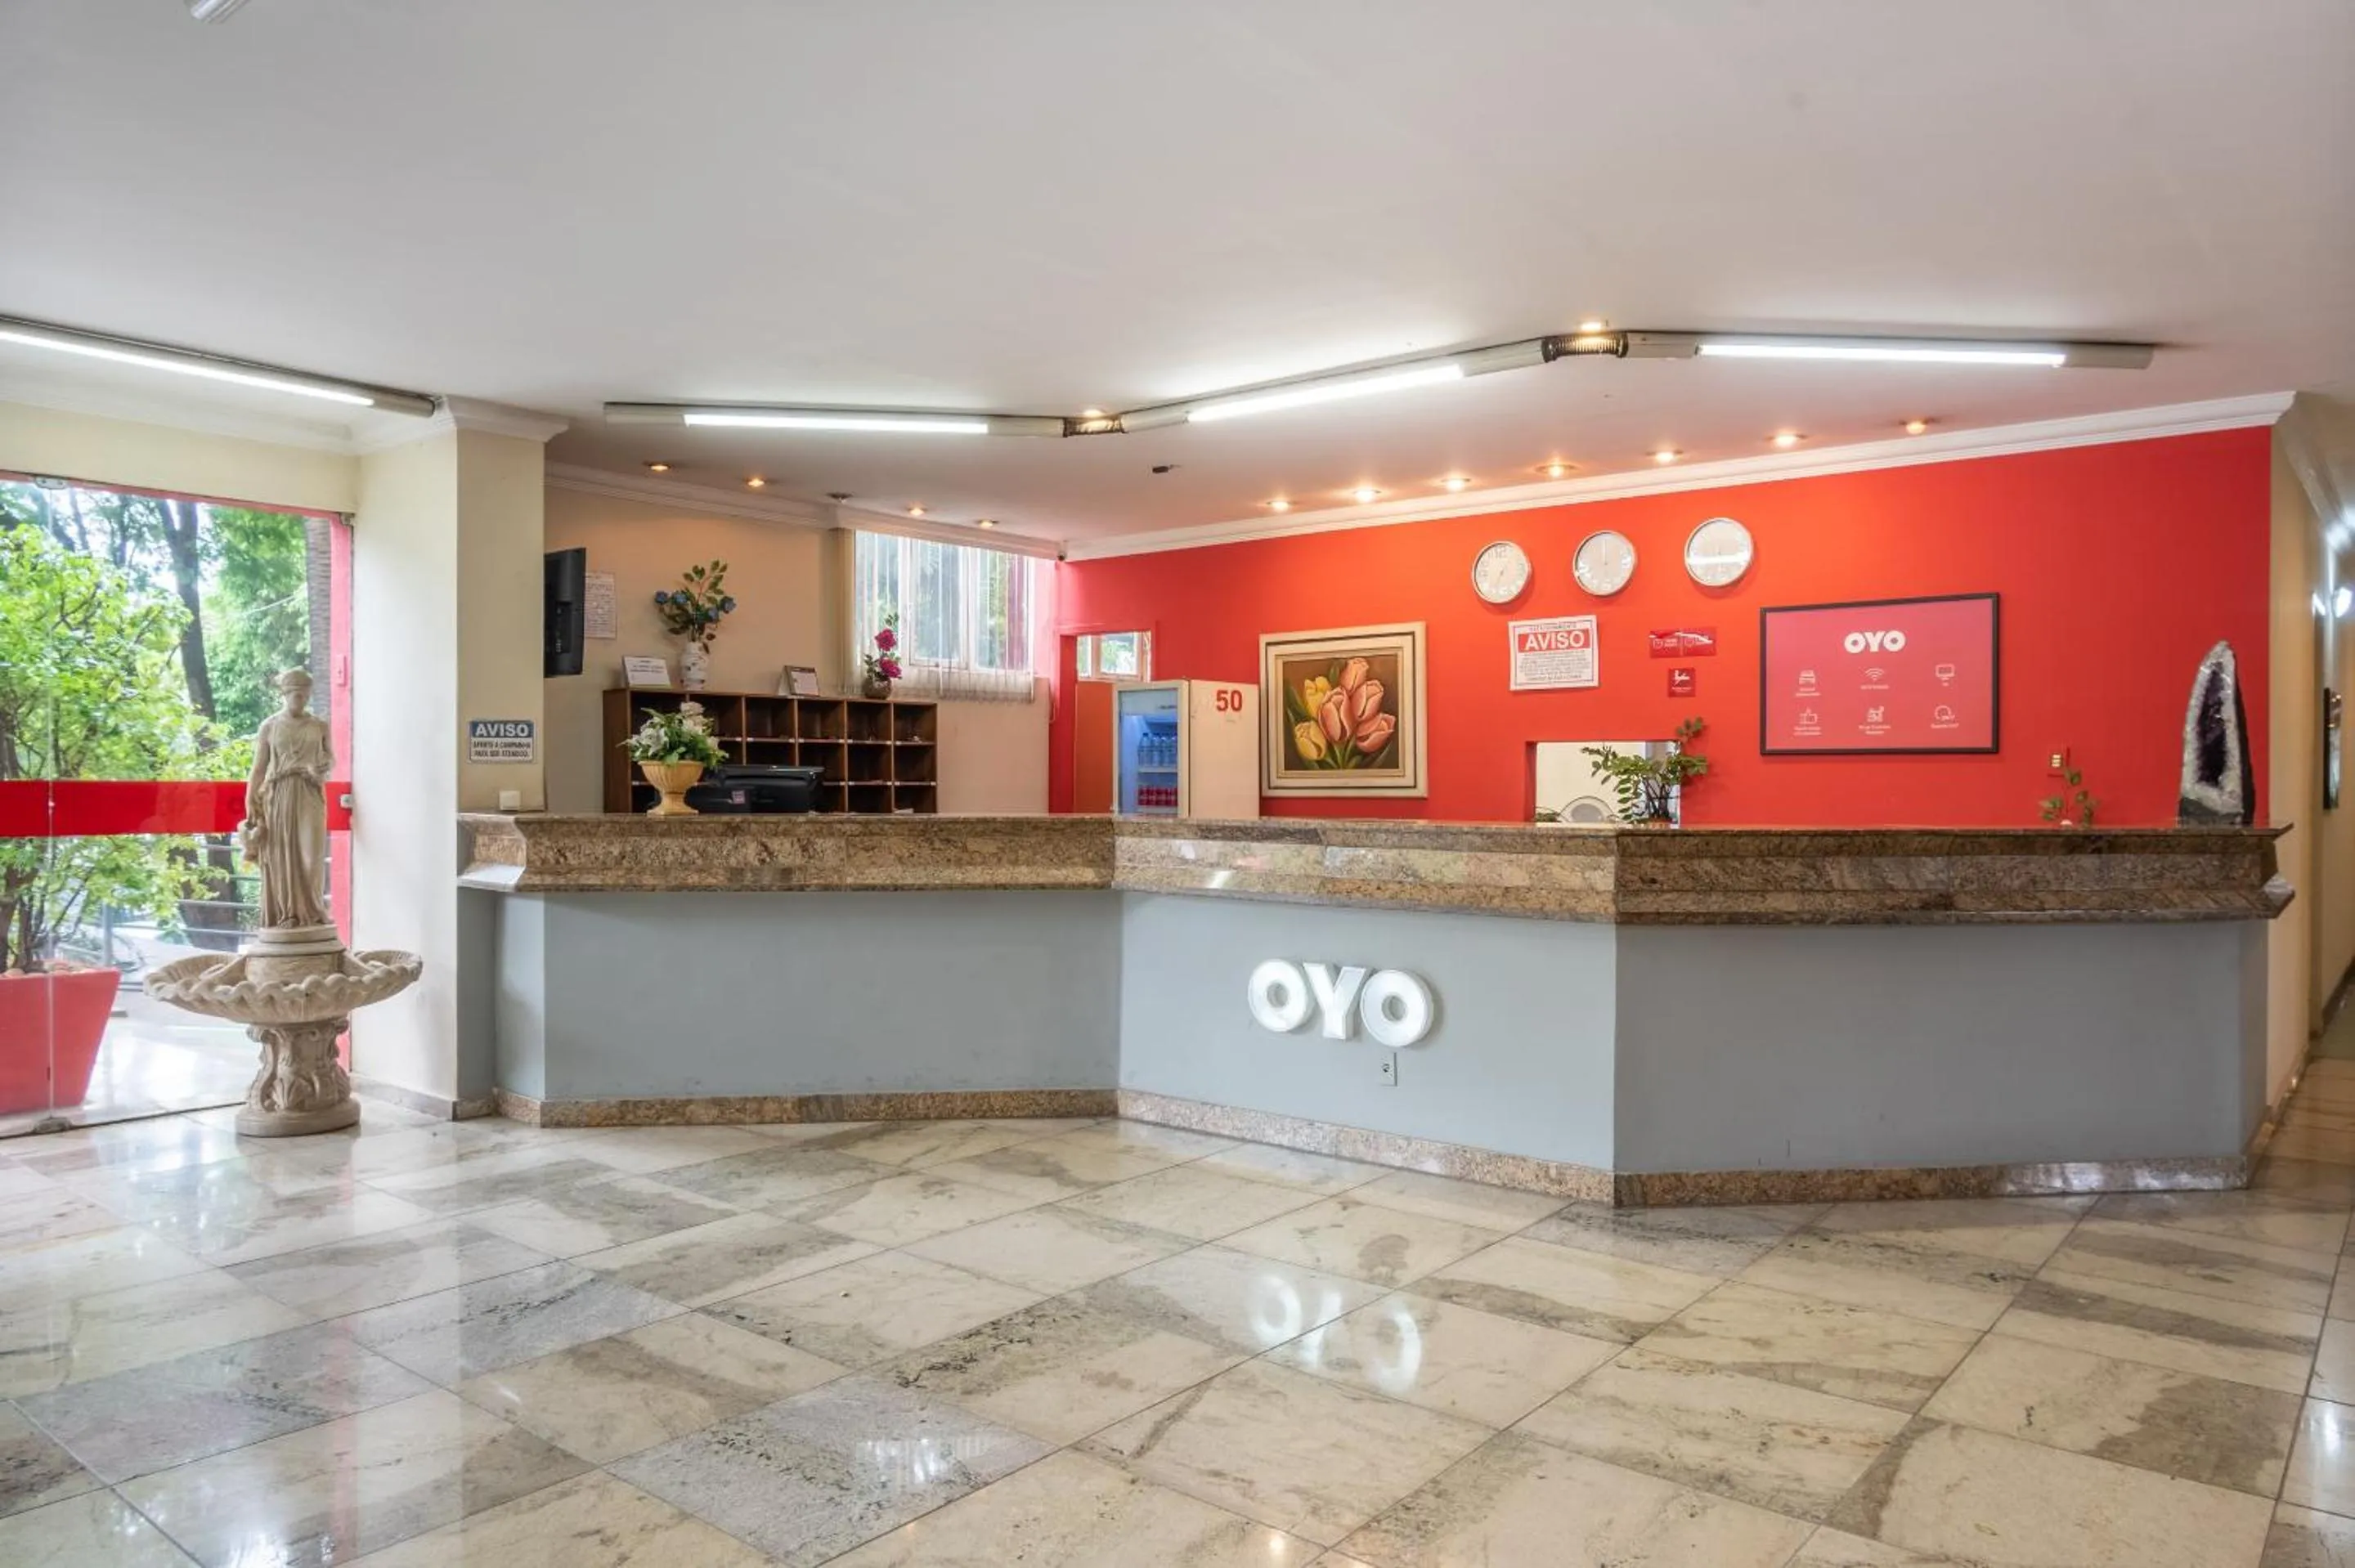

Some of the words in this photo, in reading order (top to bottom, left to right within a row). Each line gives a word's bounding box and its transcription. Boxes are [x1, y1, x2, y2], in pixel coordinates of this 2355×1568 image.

[1524, 630, 1585, 651] AVISO
[1844, 630, 1906, 653] OYO
[1216, 689, 1243, 712] 50
[475, 723, 529, 737] AVISO
[1247, 958, 1434, 1047] OYO
